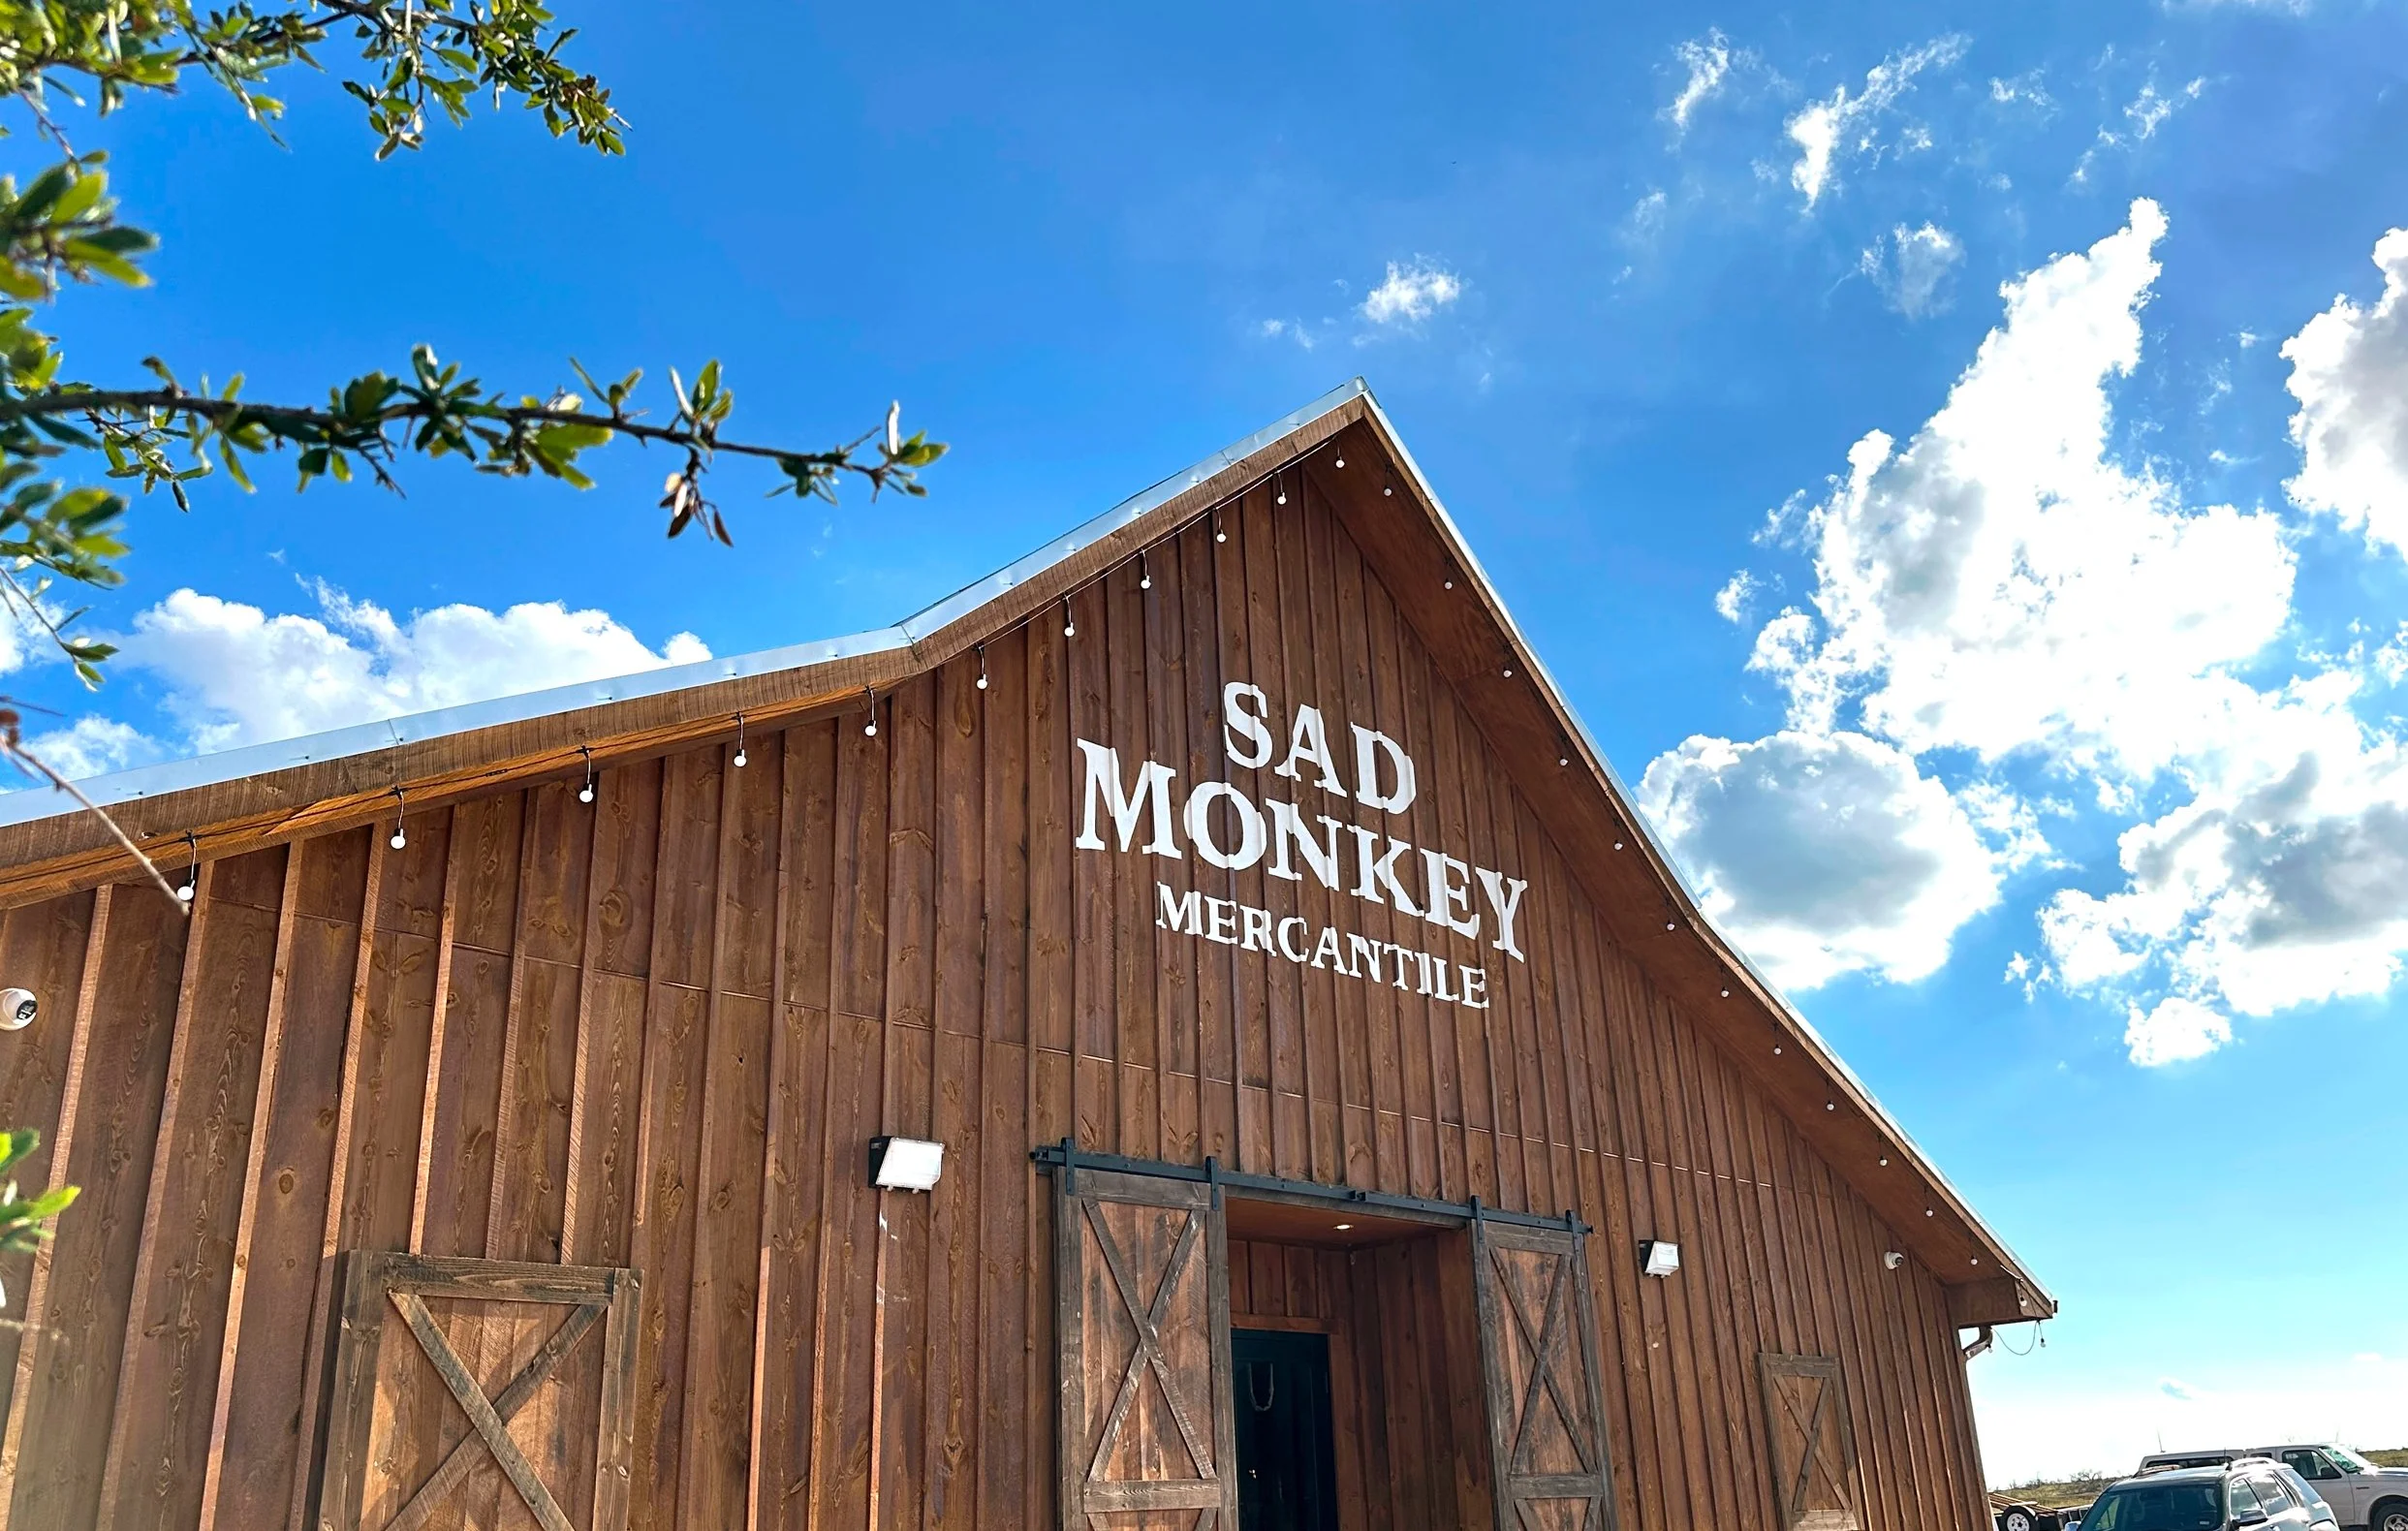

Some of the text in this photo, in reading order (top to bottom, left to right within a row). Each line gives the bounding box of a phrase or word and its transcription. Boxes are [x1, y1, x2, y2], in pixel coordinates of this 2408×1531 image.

[1224, 681, 1417, 815] SAD
[1076, 737, 1528, 964] MONKEY
[1156, 881, 1490, 1010] MERCANTILE
